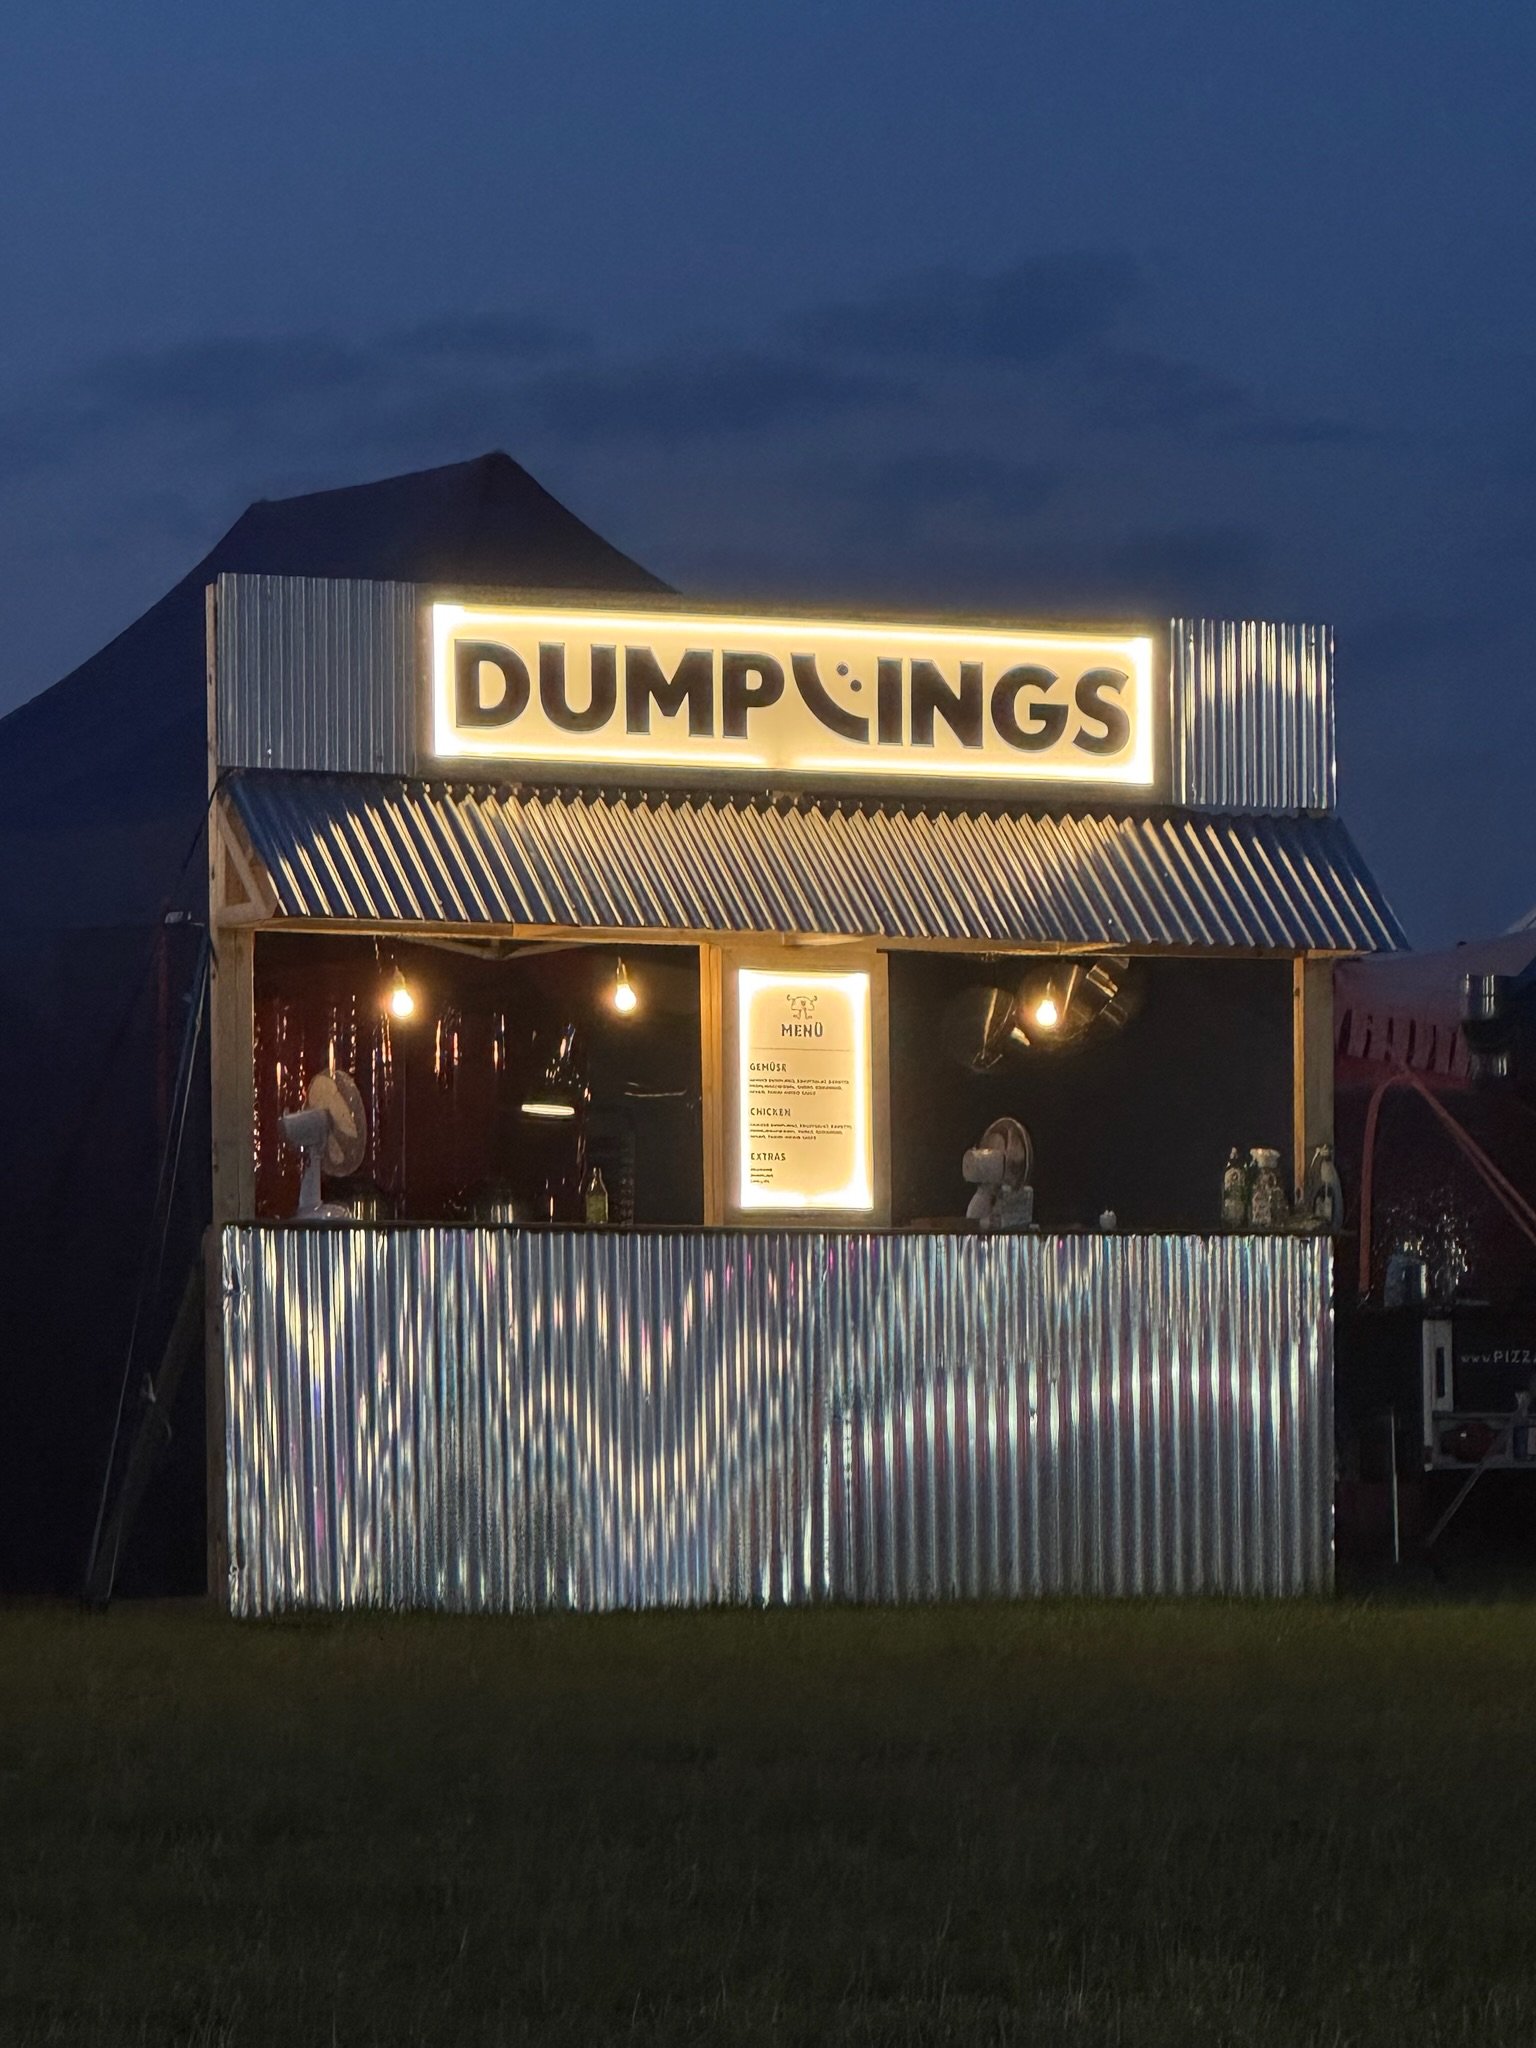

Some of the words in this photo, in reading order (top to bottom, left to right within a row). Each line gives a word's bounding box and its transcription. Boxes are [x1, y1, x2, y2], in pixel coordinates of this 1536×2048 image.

[454, 638, 1132, 756] DUMPLINGS
[781, 1021, 824, 1038] MENÜ
[750, 1107, 791, 1117] CHICKEN
[750, 1152, 786, 1162] EXTRAS
